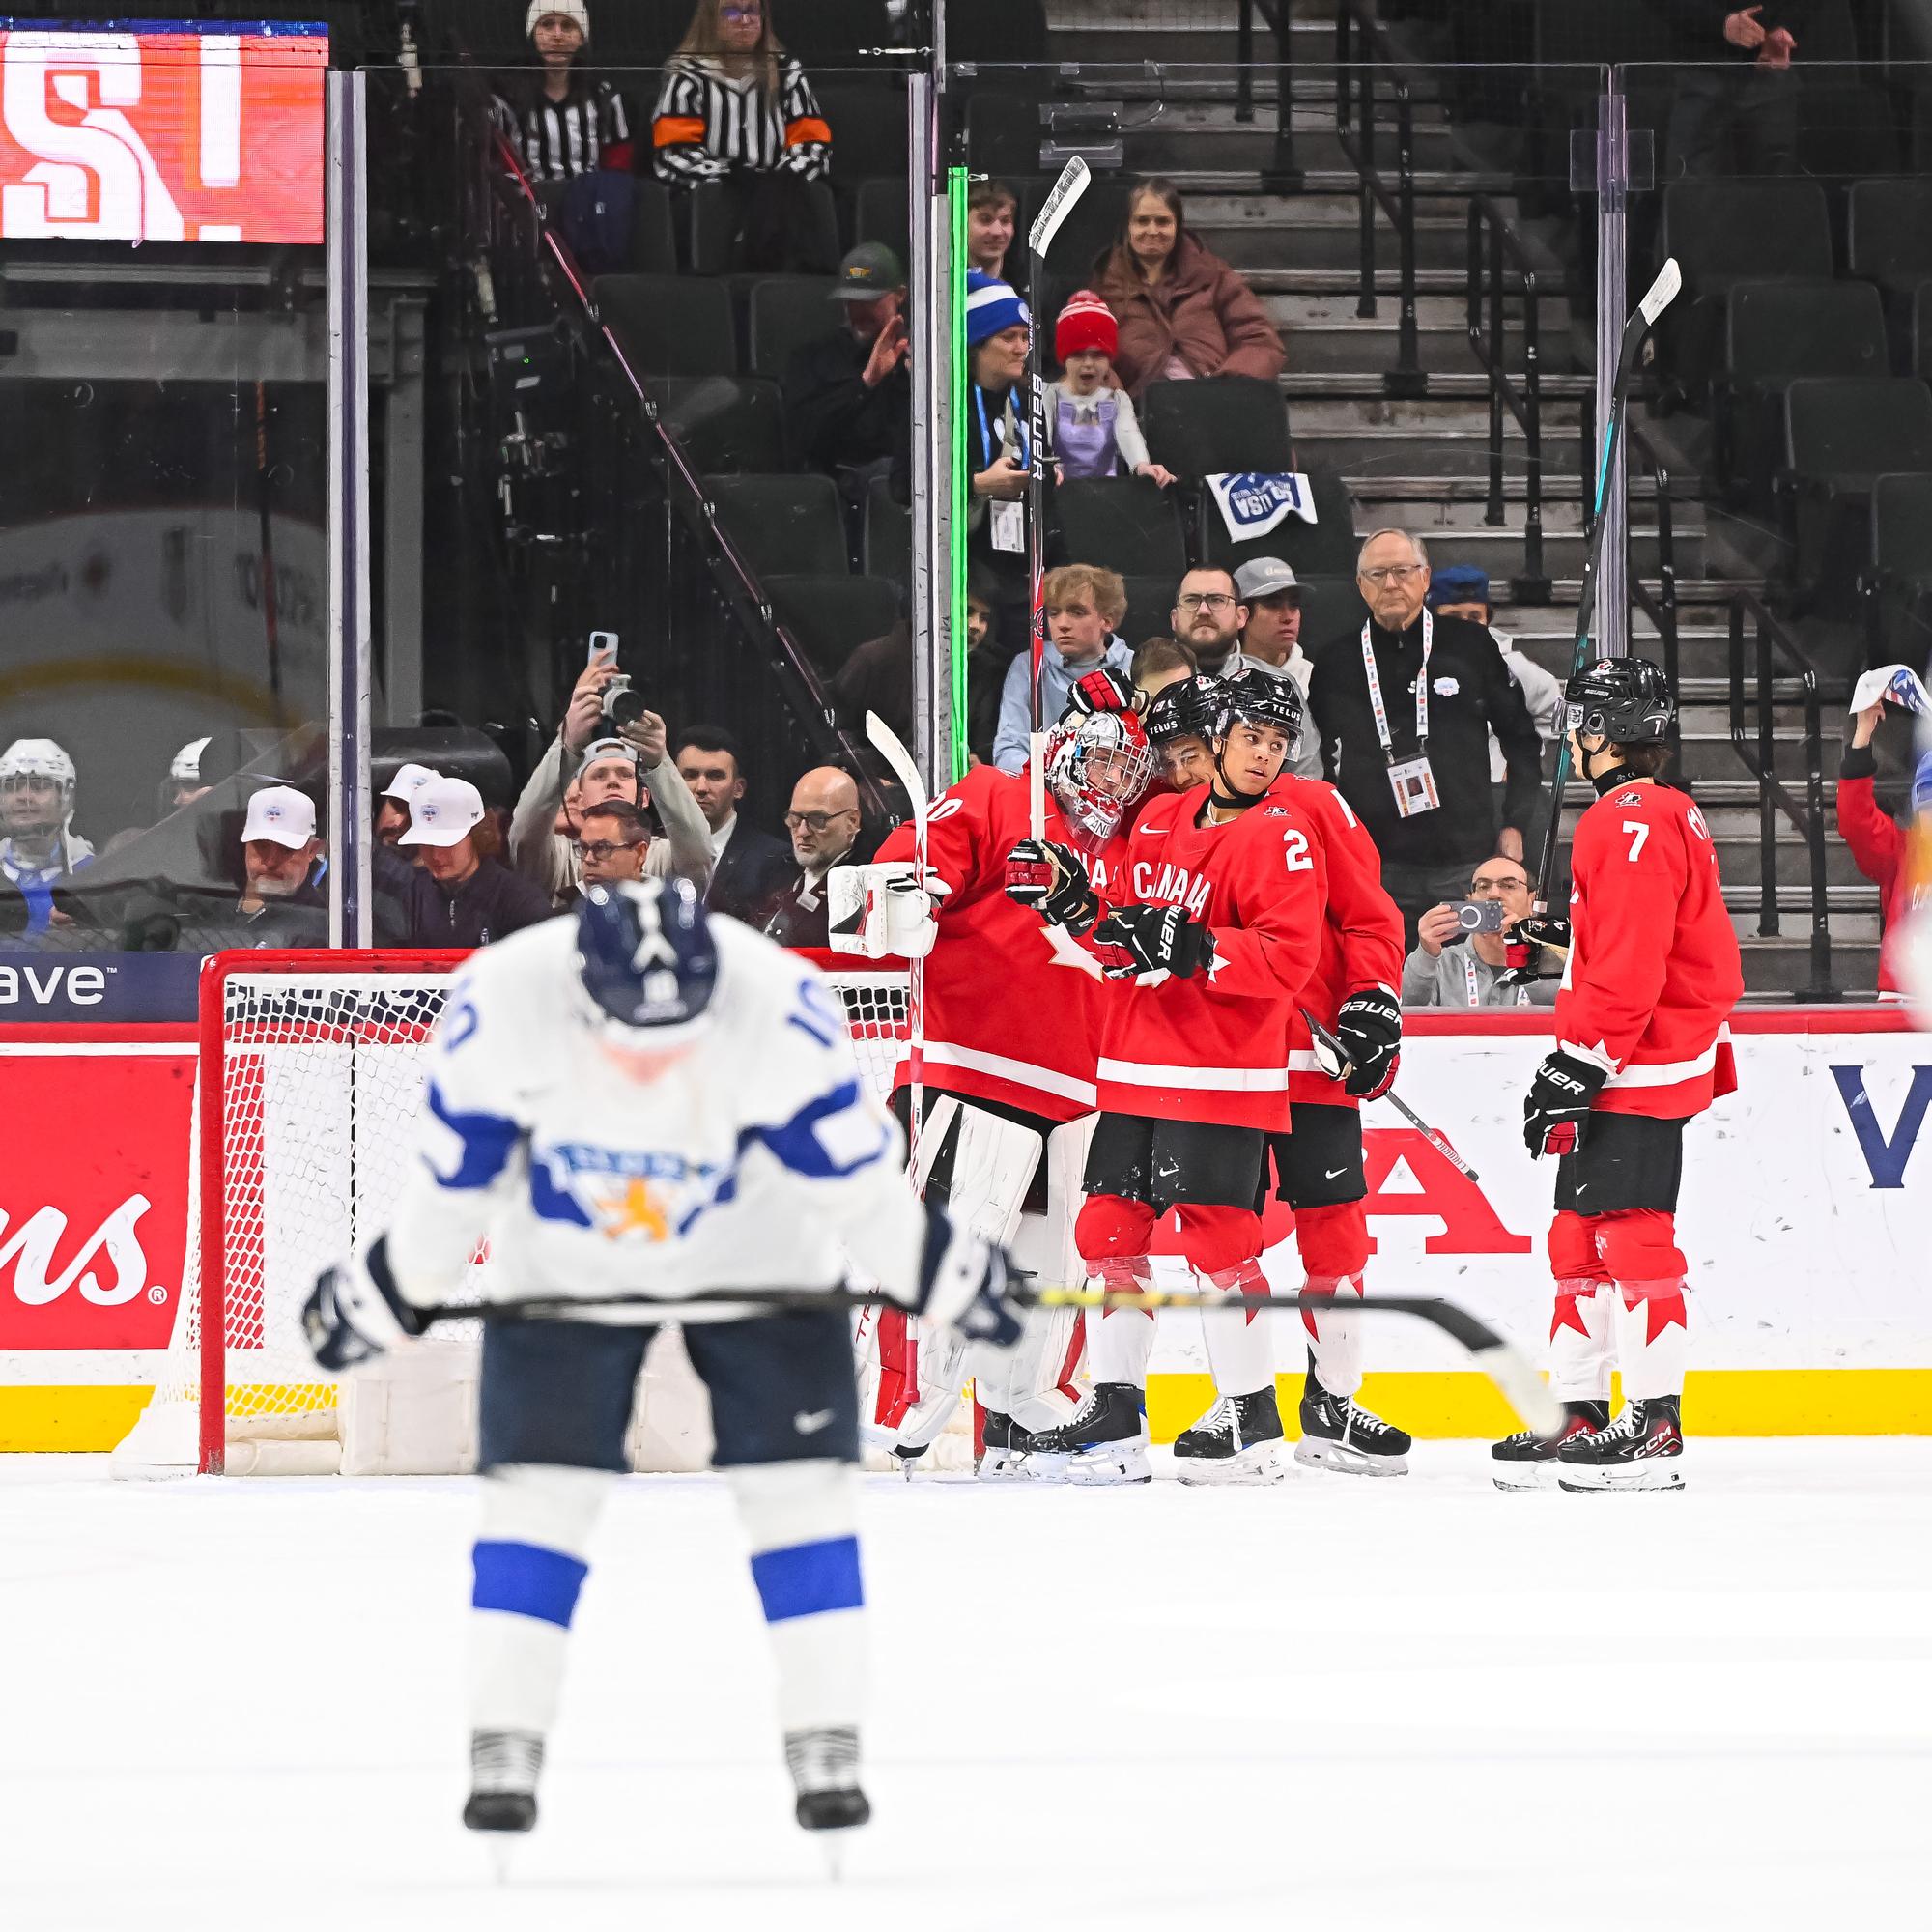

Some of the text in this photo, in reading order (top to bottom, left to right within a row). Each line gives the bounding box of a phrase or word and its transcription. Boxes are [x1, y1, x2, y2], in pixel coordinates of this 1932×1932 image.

[1150, 720, 1179, 734] TELUS
[1272, 703, 1300, 722] TELUS
[1283, 828, 1315, 872] 2
[1622, 821, 1650, 863] 7
[1634, 1425, 1672, 1460] CCM
